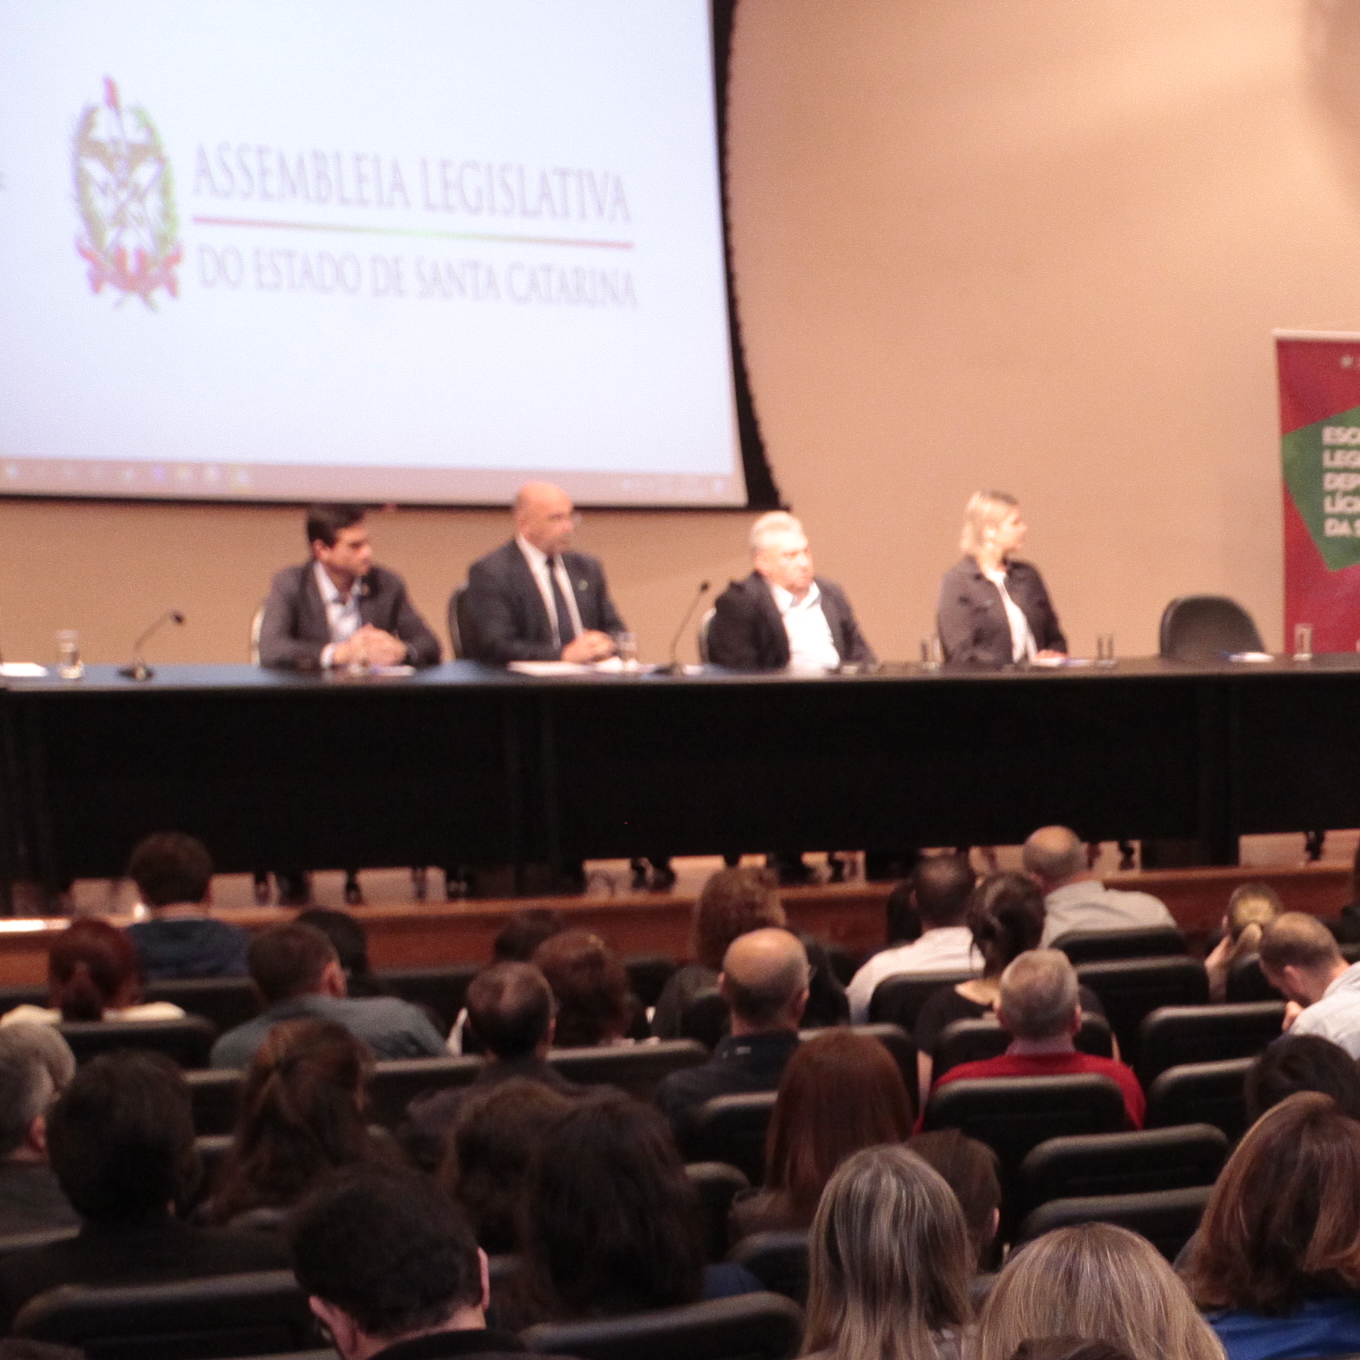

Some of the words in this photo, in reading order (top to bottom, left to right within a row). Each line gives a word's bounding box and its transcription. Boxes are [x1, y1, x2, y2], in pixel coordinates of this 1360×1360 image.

[193, 143, 411, 210] ASSEMBLEIA
[419, 158, 632, 225] LEGISLATIVA
[197, 243, 245, 291] DO
[253, 247, 362, 296] ESTADO
[369, 253, 409, 299] DE
[414, 257, 500, 300] SANTA
[504, 263, 638, 309] CATARINA
[1324, 518, 1353, 538] DA
